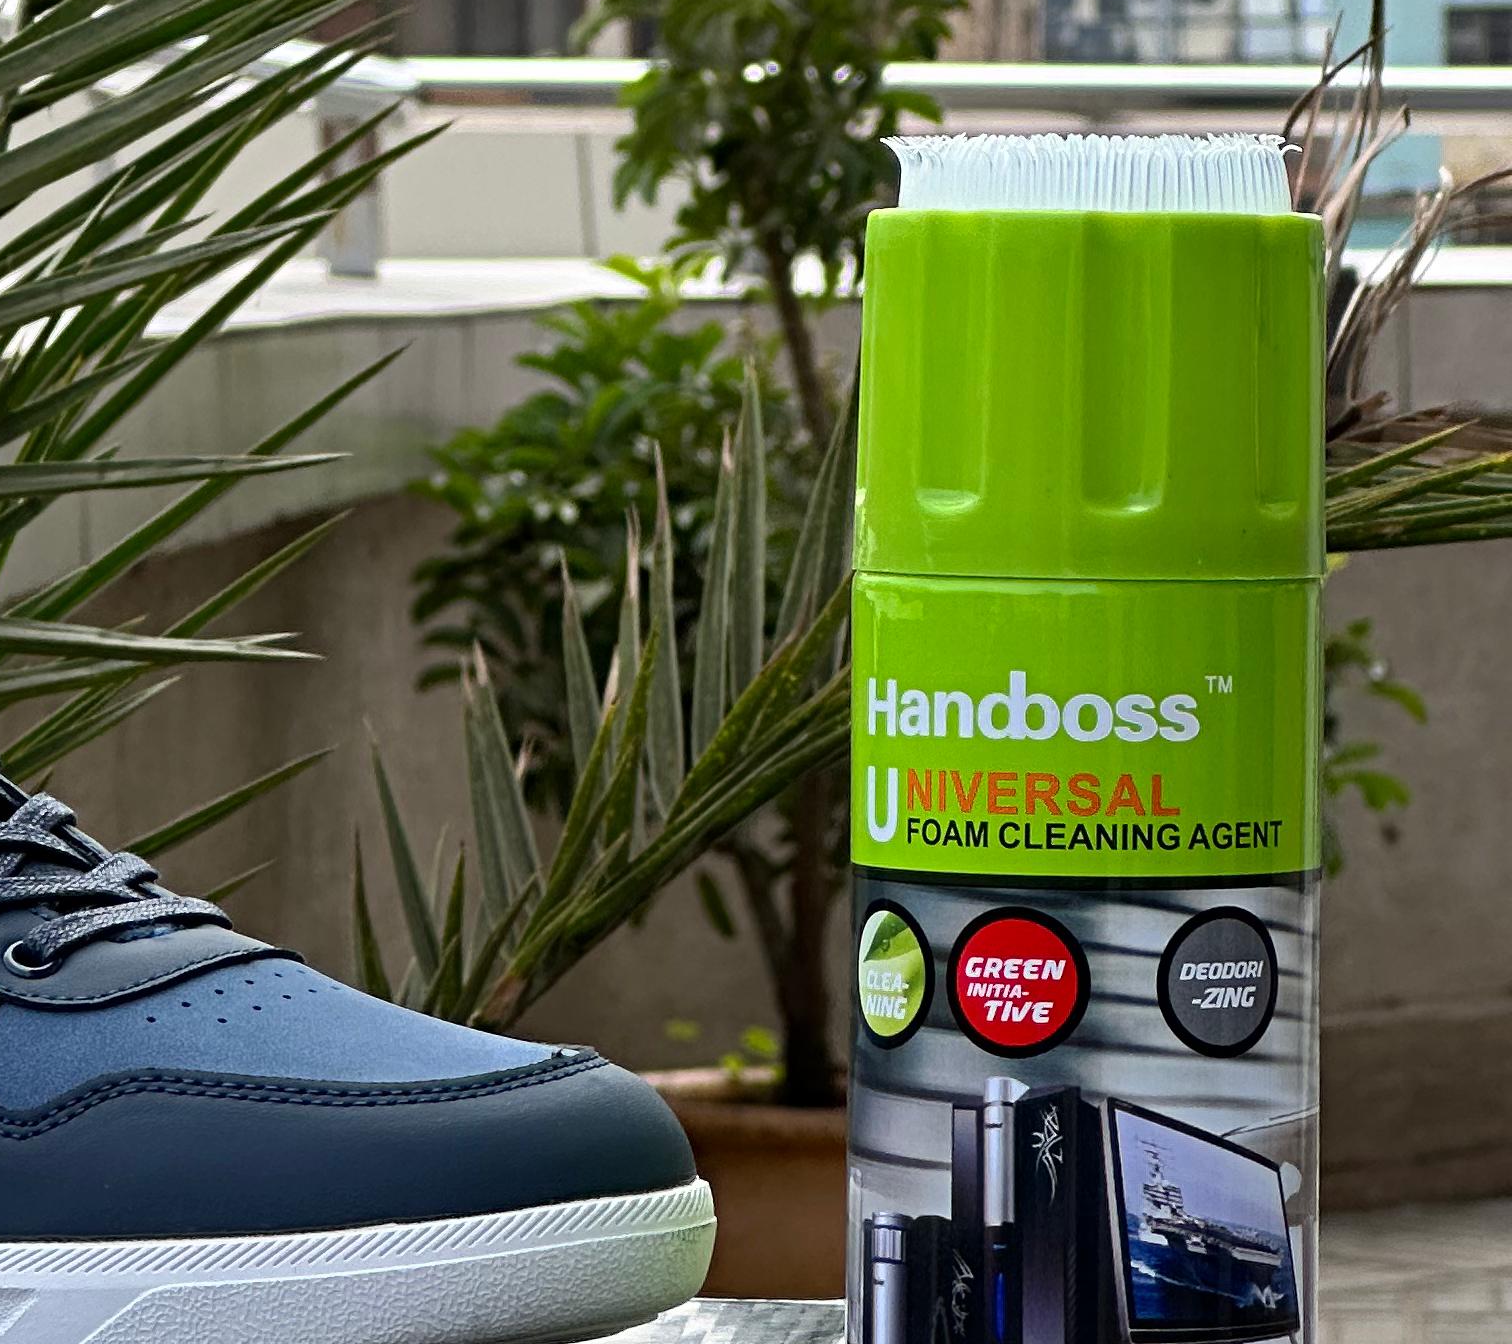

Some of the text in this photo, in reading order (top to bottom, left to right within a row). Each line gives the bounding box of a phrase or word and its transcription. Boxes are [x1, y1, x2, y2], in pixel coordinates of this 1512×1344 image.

[868, 670, 1201, 742] Handboss
[867, 766, 1181, 843] UNIVERSAL
[906, 818, 1283, 850] FOAM CLEANING AGENT
[965, 956, 1065, 981] GREEN
[1179, 960, 1264, 981] DEODORI
[966, 982, 1030, 1000] INITIA-
[1191, 986, 1256, 1009] -ZING
[984, 1000, 1054, 1023] TIVE
